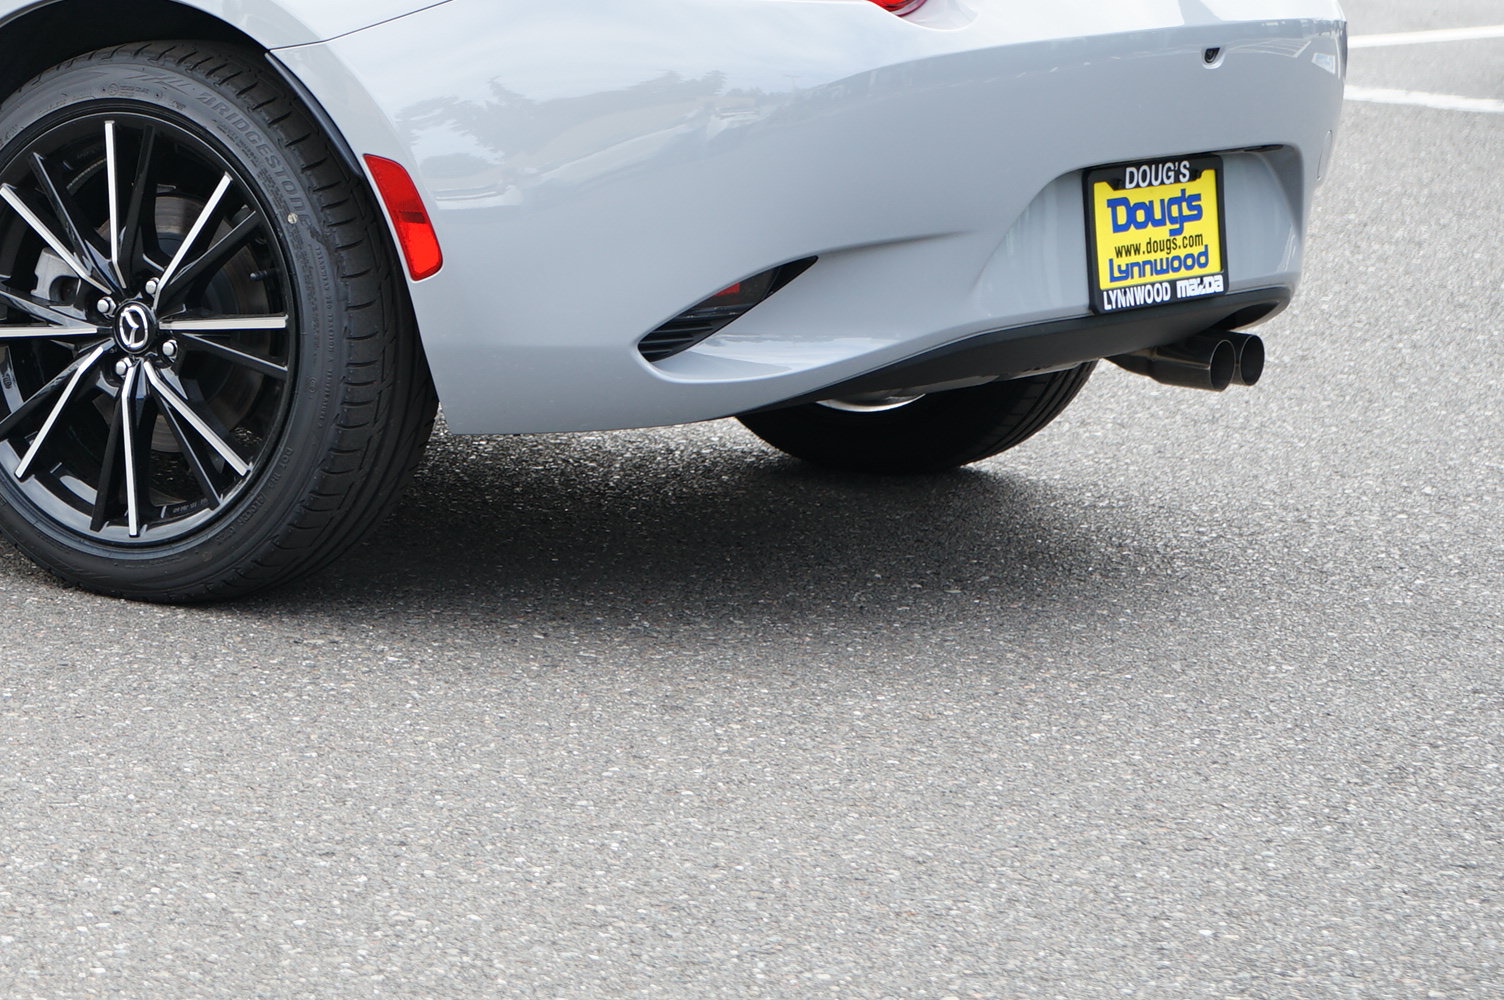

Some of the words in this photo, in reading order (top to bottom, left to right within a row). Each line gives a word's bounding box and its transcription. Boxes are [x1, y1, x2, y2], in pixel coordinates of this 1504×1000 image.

[195, 90, 313, 228] BRIDGESTONE
[1124, 160, 1191, 189] DOUG'S
[1114, 233, 1204, 259] www.dougs.com
[1108, 244, 1209, 283] Lynnwood
[1102, 282, 1171, 311] LYNNWOOD
